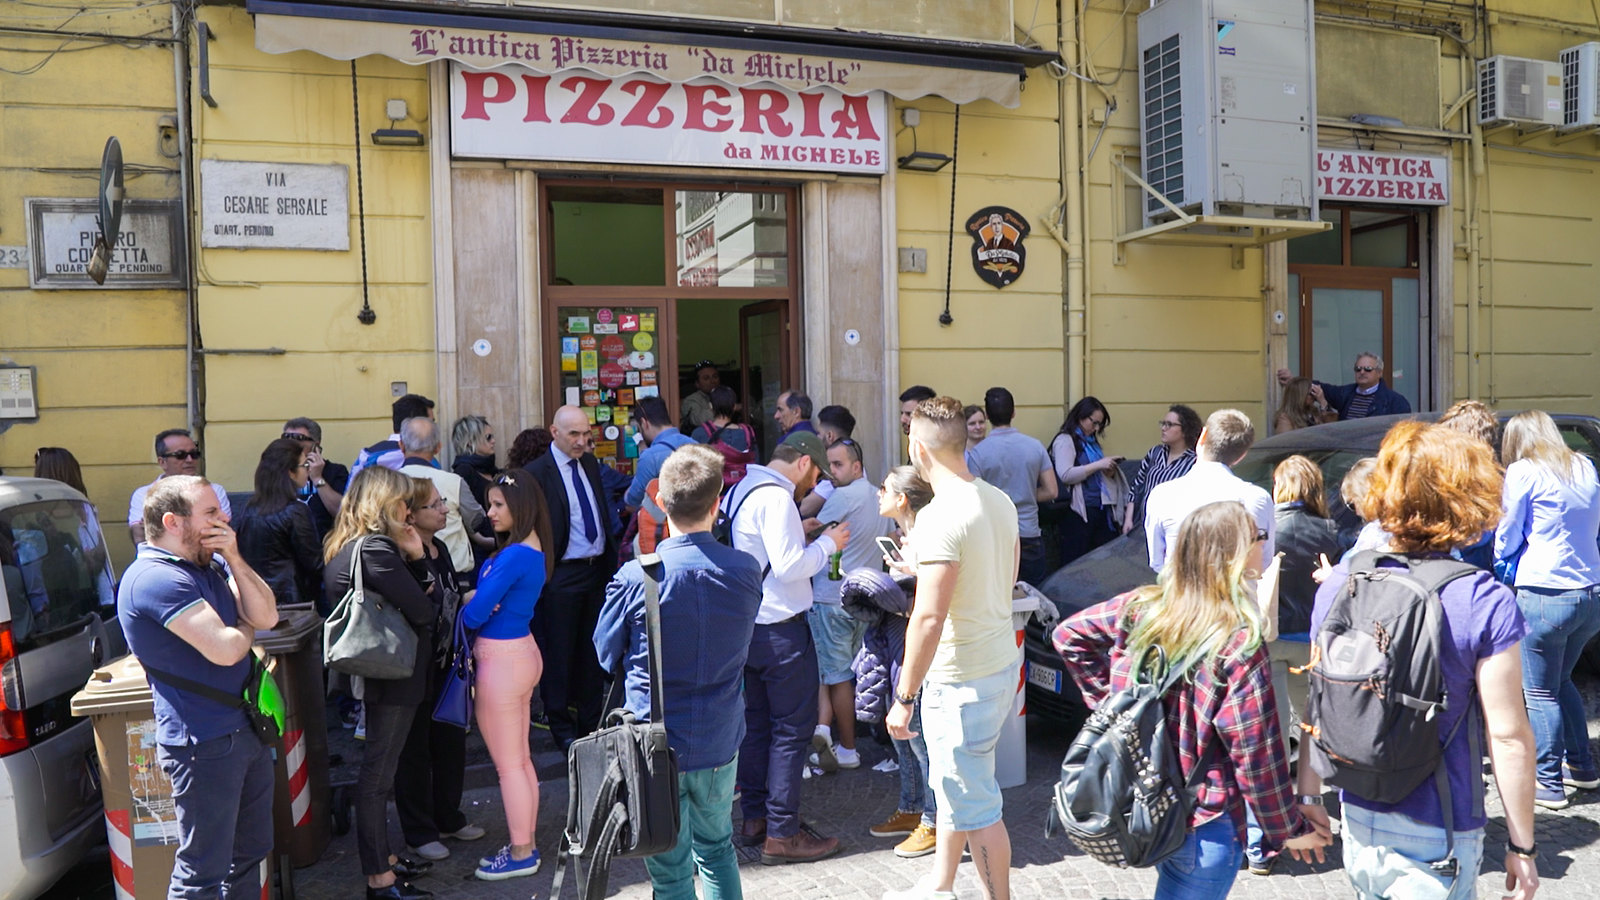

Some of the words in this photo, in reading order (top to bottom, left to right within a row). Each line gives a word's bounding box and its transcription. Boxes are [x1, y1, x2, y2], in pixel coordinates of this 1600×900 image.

[410, 28, 541, 61] L'antica
[550, 36, 667, 70] Pizzeria
[461, 70, 881, 141] PIZZERIA
[723, 142, 752, 160] da
[761, 144, 880, 166] MICHELE
[1317, 152, 1434, 178] L'ANTICA
[265, 172, 286, 187] VIA
[224, 195, 269, 214] CESARE
[276, 197, 328, 216] SERSALE
[243, 225, 274, 237] PENDINO
[68, 247, 149, 263] COETTA
[119, 263, 163, 273] PENDINO
